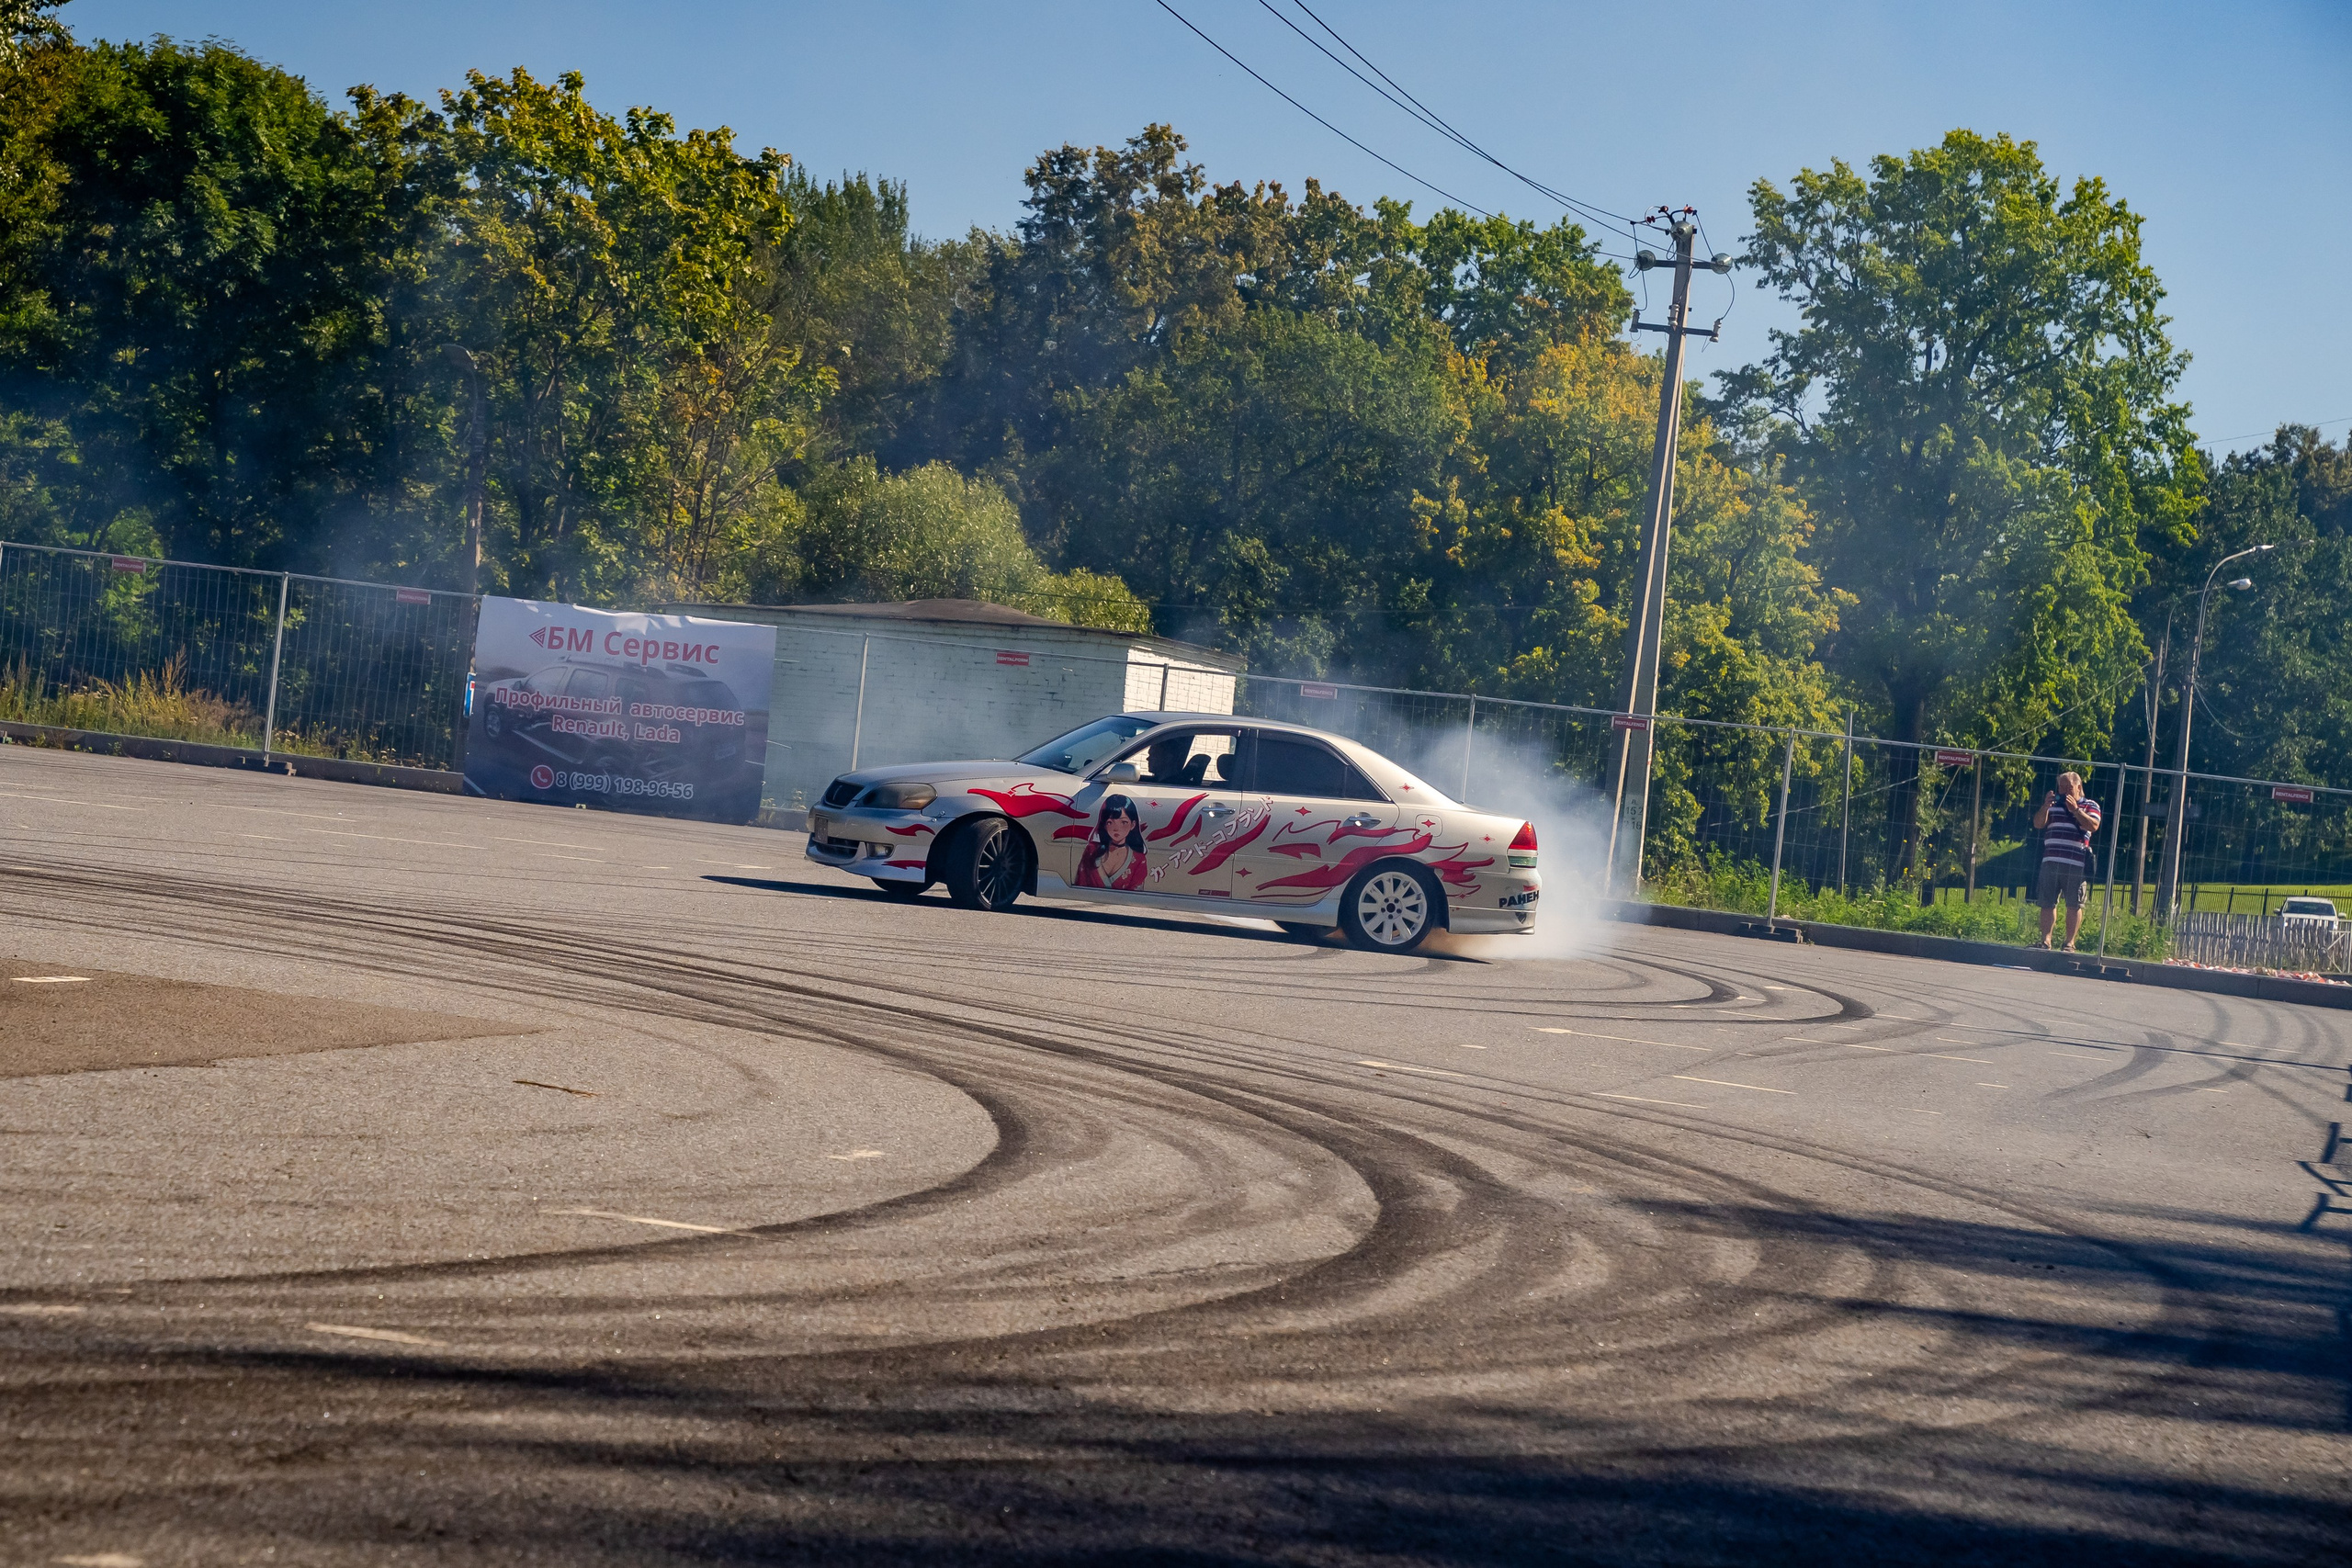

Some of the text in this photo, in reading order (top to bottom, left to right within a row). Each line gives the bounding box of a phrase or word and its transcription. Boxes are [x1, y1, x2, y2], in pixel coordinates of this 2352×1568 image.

[547, 626, 720, 666] БМ Сервис
[494, 687, 745, 727] Профильный автосервис
[551, 714, 681, 743] Renault, Lada
[1614, 719, 1645, 728] RENTALFENCE
[1938, 754, 1971, 762] RENTALFENCE
[556, 771, 694, 800] 8 (999) 198-96-56
[2275, 791, 2309, 799] RENTALFENCE
